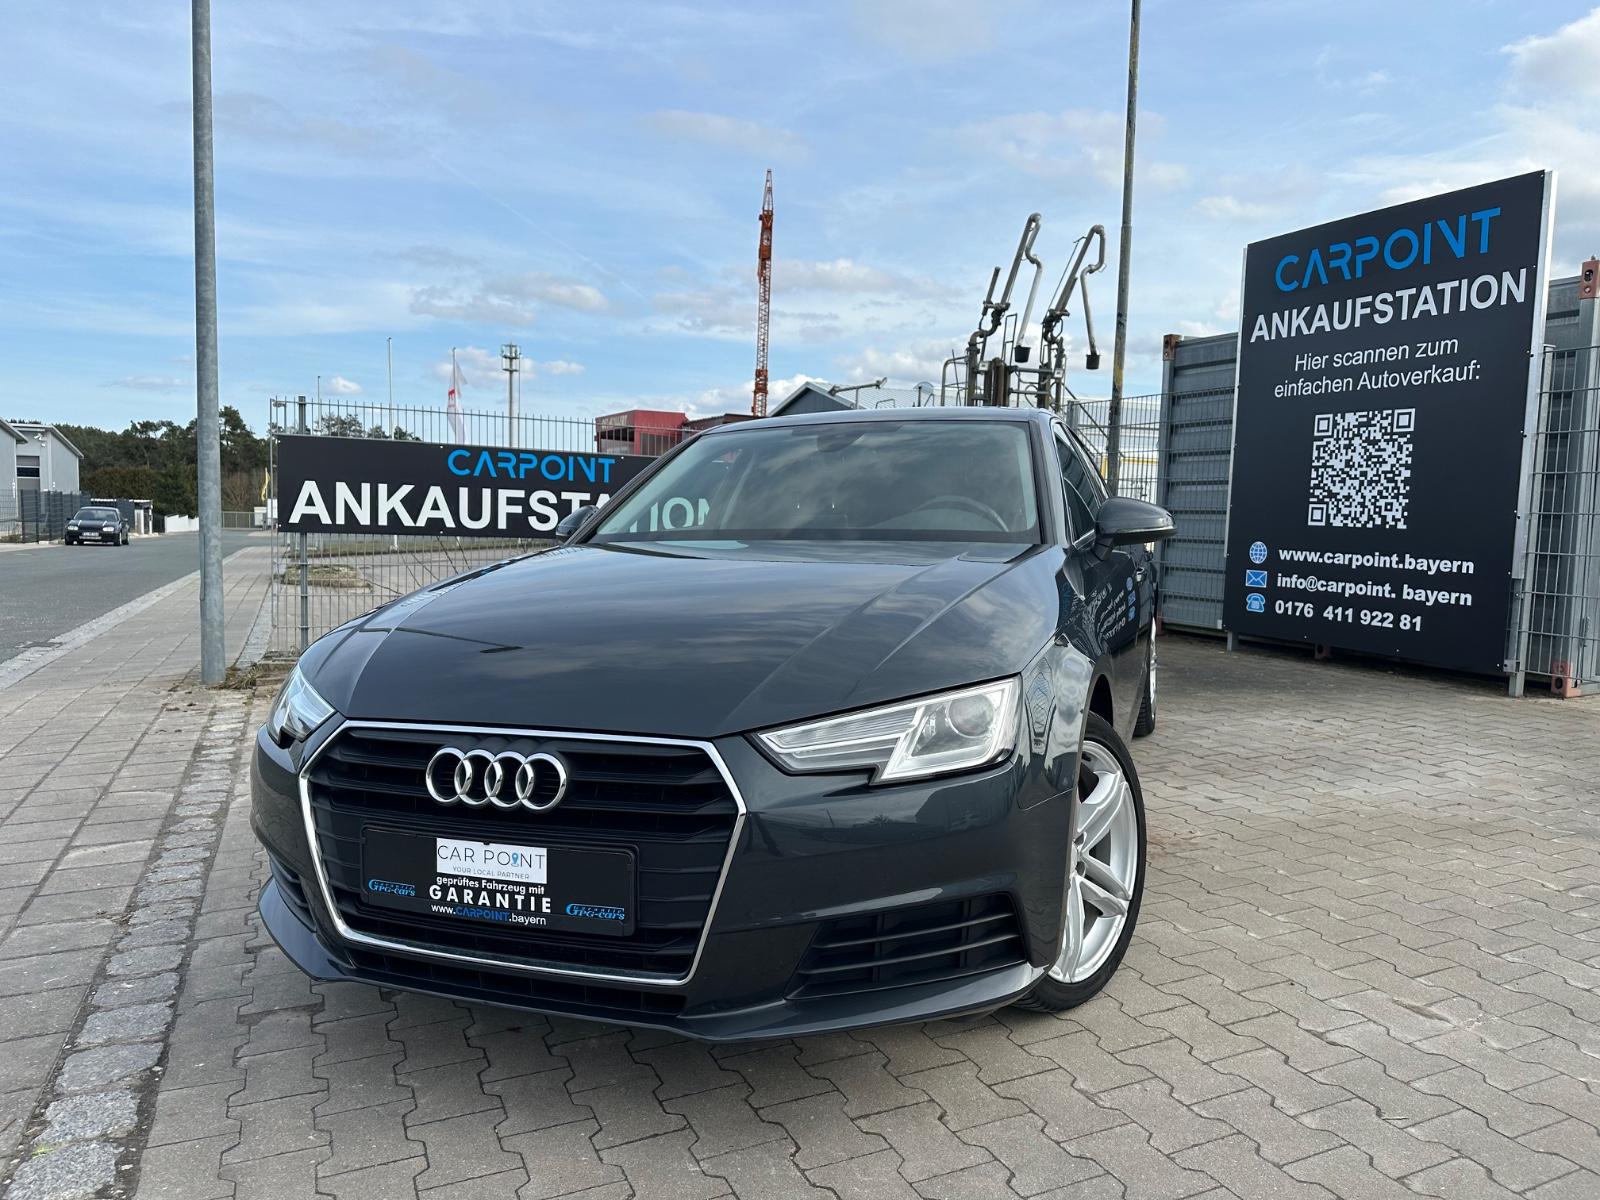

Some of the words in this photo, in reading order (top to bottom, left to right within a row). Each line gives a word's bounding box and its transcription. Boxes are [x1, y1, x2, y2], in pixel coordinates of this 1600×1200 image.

[1275, 207, 1500, 292] CARPOINT
[1250, 268, 1527, 343] ANKAUFSTATION
[1295, 352, 1330, 372] Hier
[1333, 344, 1409, 368] scannen
[1416, 337, 1459, 358] zum
[1274, 375, 1353, 398] einfachen
[1357, 359, 1481, 391] Autoverkauf:
[447, 449, 616, 484] CARPOINT
[1278, 548, 1475, 575] www.carpoint.bayern
[1402, 583, 1473, 607] bayern
[1275, 599, 1314, 619] 0176
[1322, 605, 1353, 623] 411
[1360, 610, 1394, 628] 922
[1399, 614, 1422, 632] 81
[437, 845, 475, 863] CAR
[436, 876, 479, 888] geprüftes
[482, 880, 526, 894] Fahrzeug
[528, 885, 545, 895] mit
[453, 866, 472, 875] YOUR
[473, 869, 495, 878] LOCAL
[497, 871, 530, 880] PARTNER
[429, 884, 552, 913] GARANTIE
[431, 904, 547, 926] www.CARPOINT.bayern
